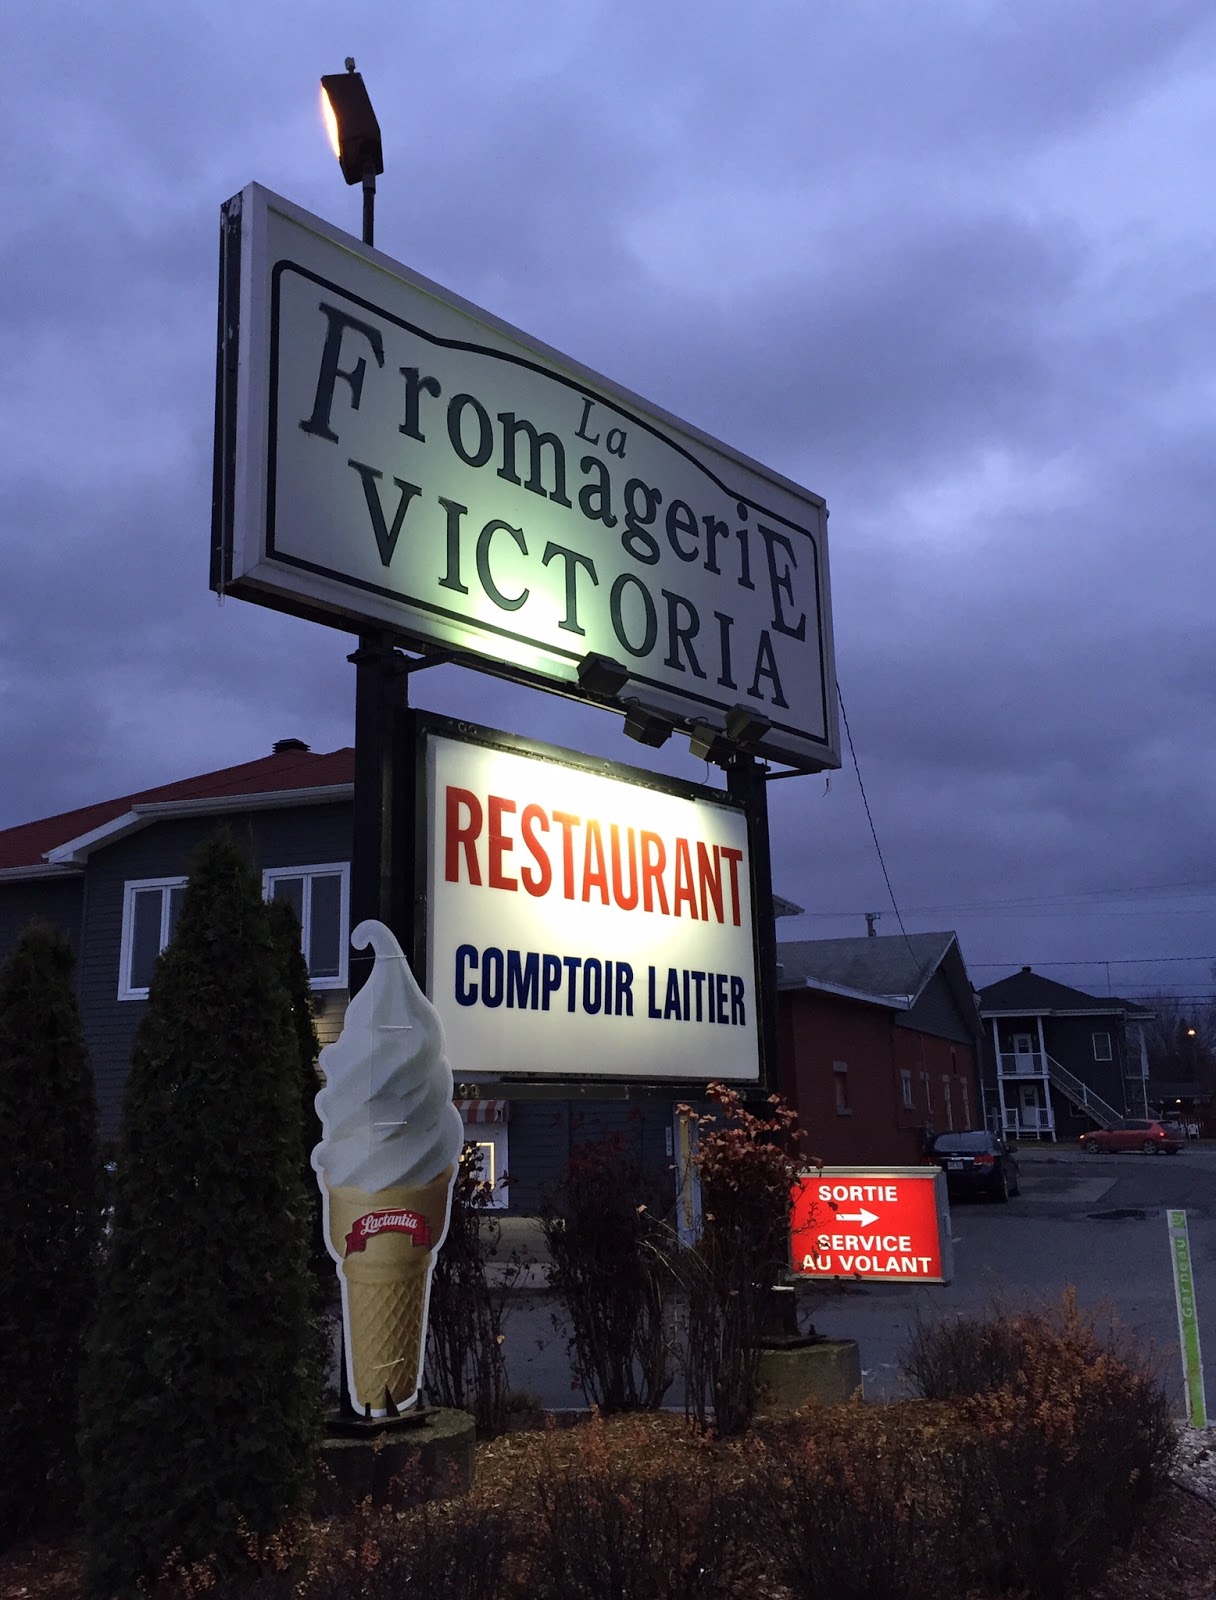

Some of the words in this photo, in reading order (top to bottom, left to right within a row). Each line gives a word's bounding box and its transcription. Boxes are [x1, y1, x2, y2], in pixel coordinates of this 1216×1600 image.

[575, 397, 628, 459] La
[299, 302, 806, 642] FromageriE
[348, 459, 790, 709] VICTORIA
[445, 785, 743, 927] RESTAURANT
[455, 944, 634, 1017] COMPTOIR
[648, 965, 747, 1026] LAITIER
[361, 1214, 417, 1235] Lactantia
[818, 1185, 898, 1202] SORTIE
[802, 1254, 832, 1270] AU
[838, 1255, 932, 1273] VOLANT
[818, 1235, 911, 1252] SERVICE
